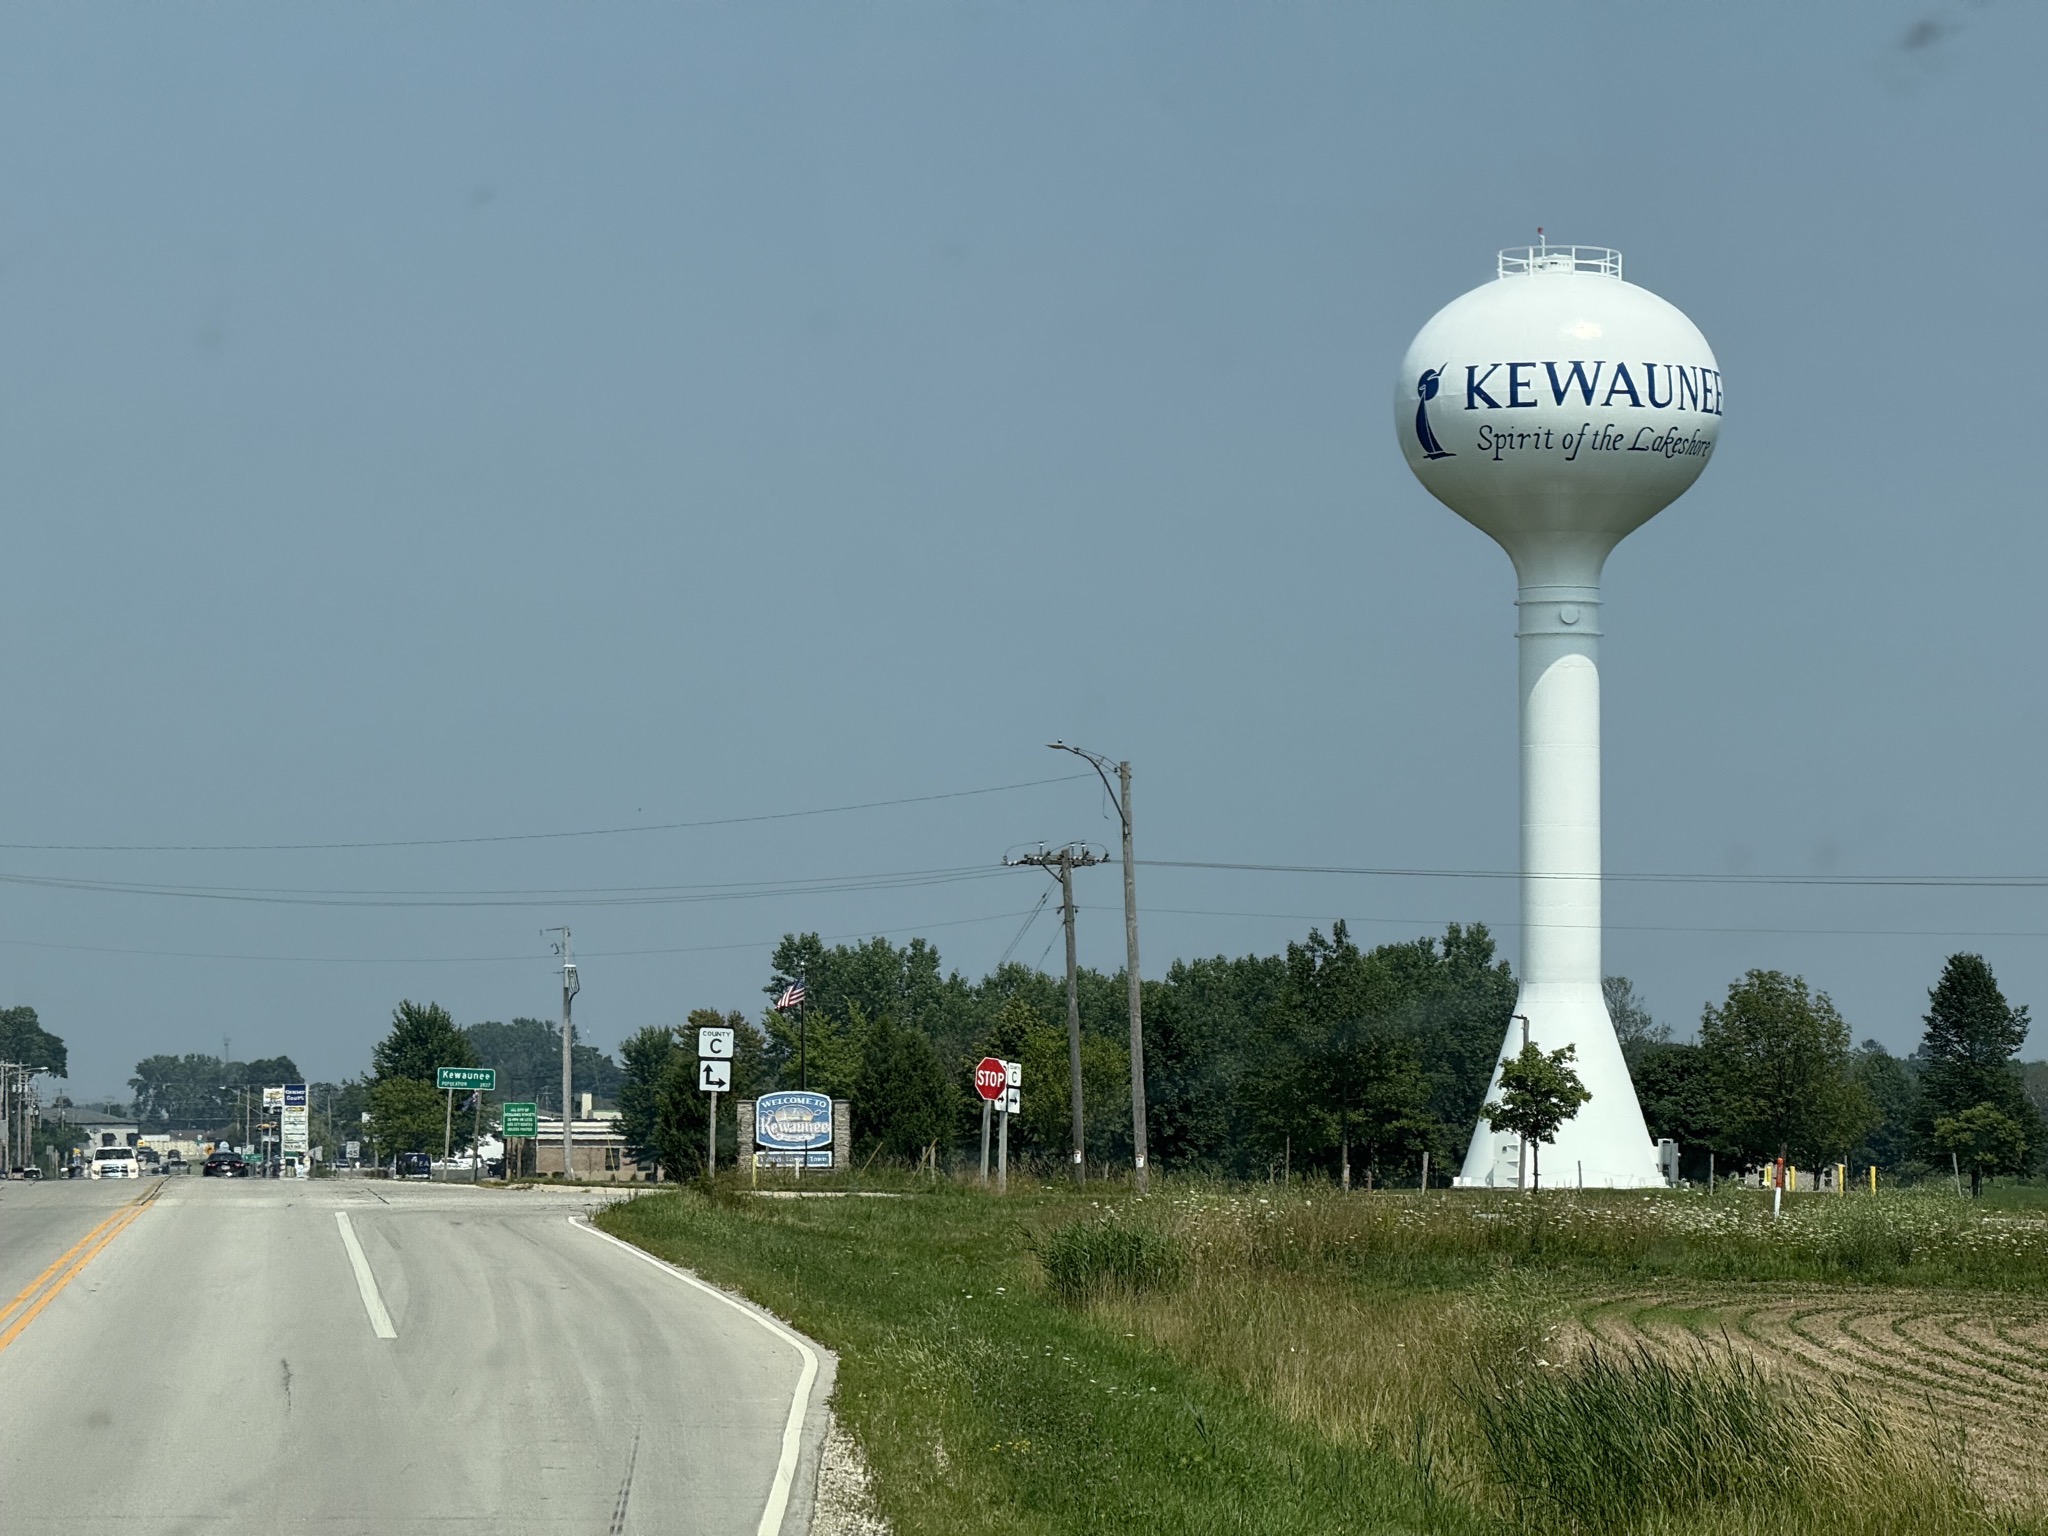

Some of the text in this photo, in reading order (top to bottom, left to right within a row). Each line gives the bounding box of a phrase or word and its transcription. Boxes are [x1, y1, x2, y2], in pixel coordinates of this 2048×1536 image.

[1464, 360, 1722, 416] KEWAUNEE
[1477, 422, 1711, 462] Spirit of the Lakeshore
[710, 1038, 722, 1054] C
[442, 1070, 490, 1081] Kewaunee
[977, 1069, 1005, 1088] STOP
[1011, 1071, 1018, 1084] C
[761, 1097, 827, 1108] WELCOME TO
[760, 1115, 830, 1135] Kewaunee
